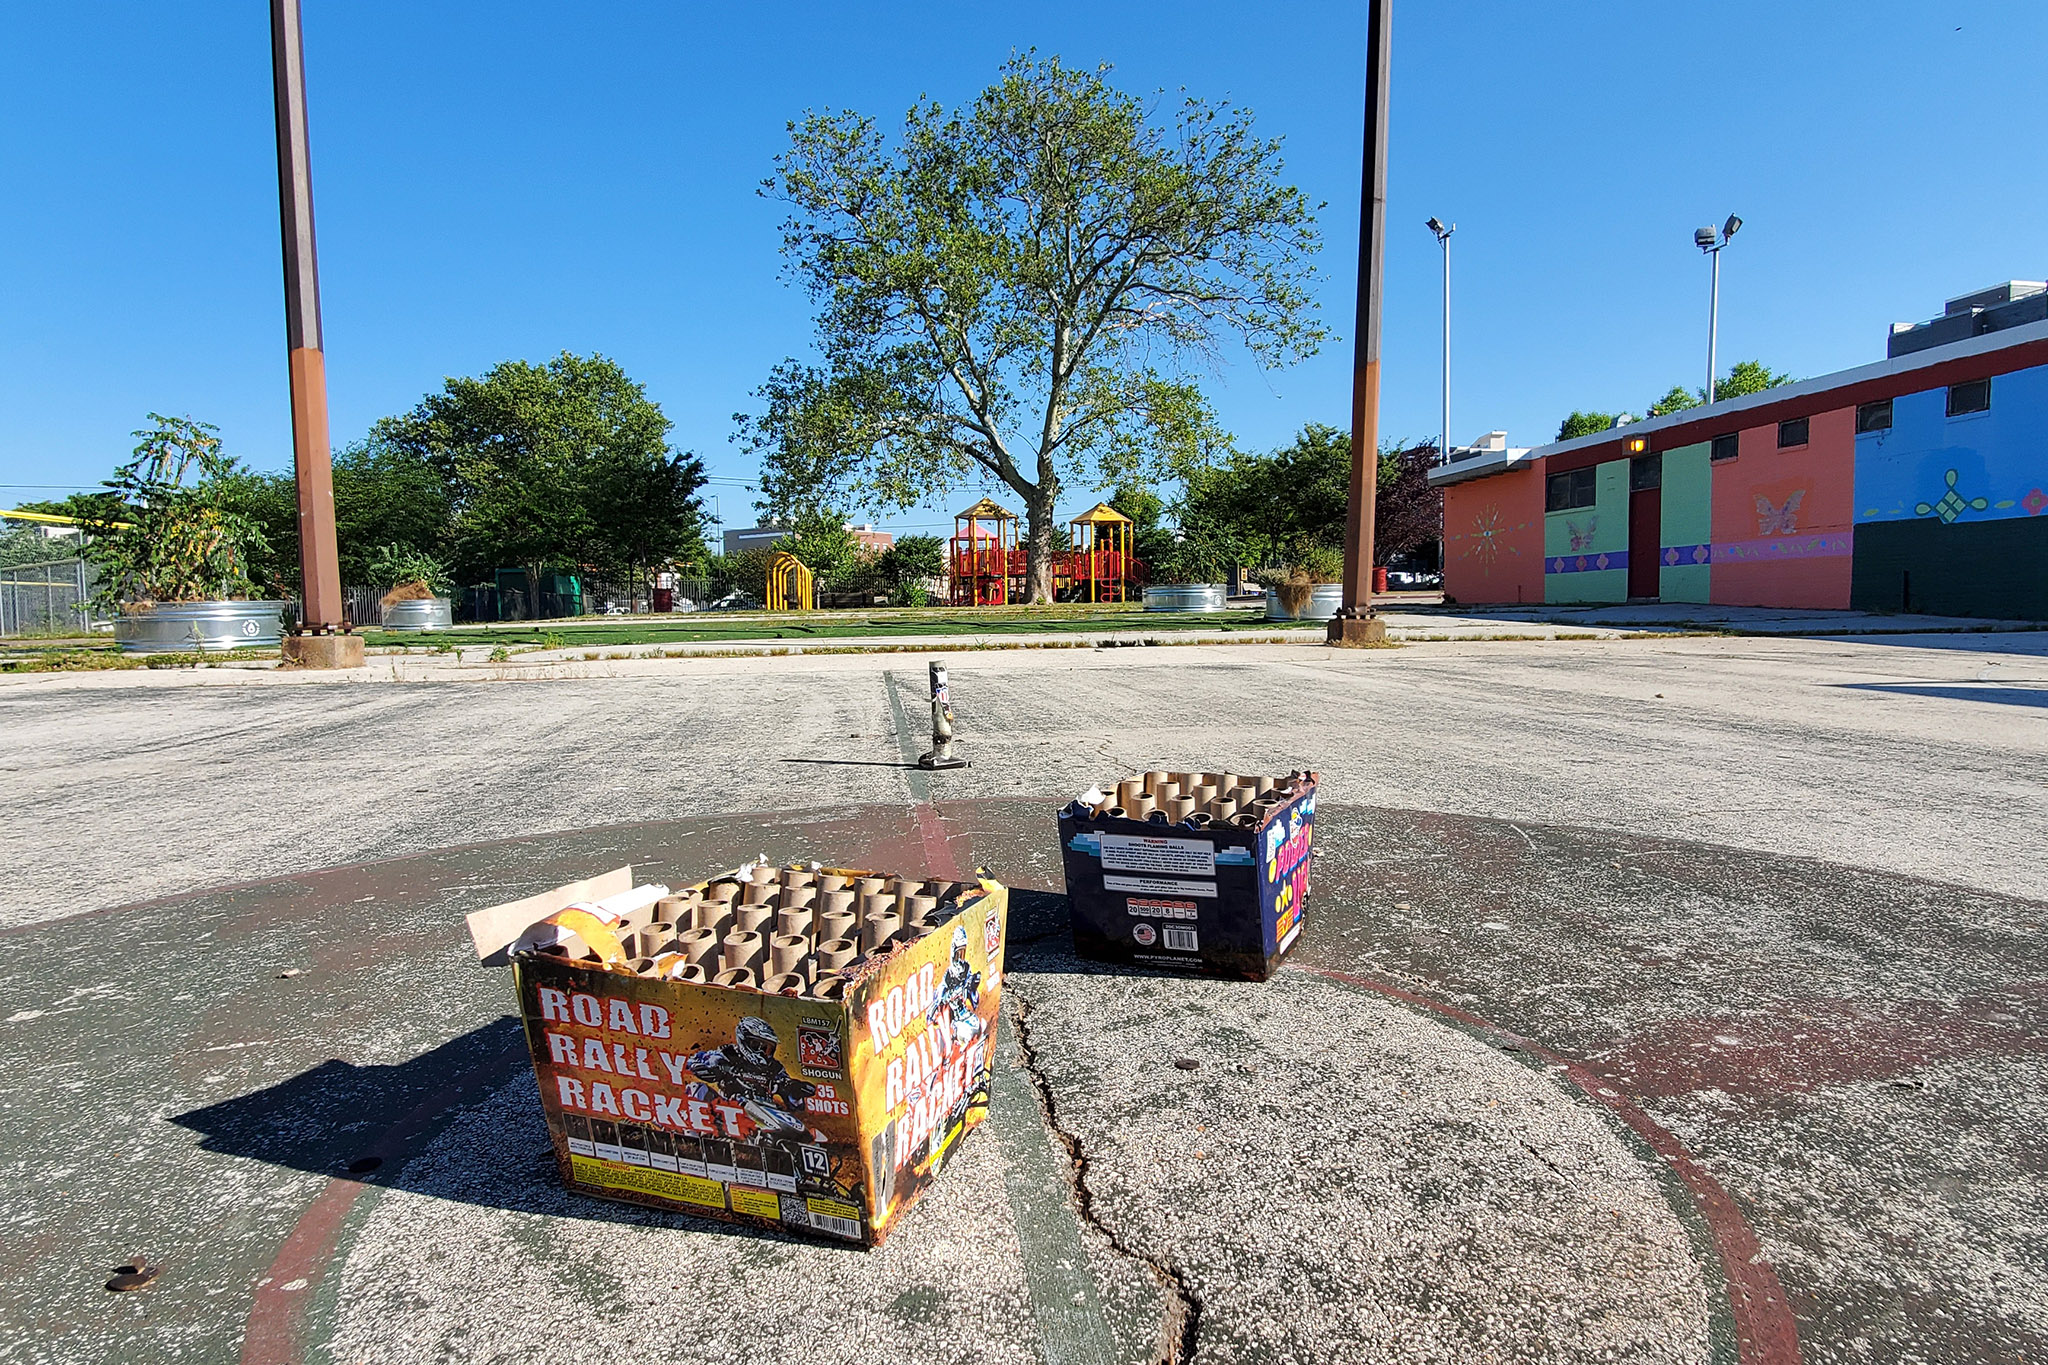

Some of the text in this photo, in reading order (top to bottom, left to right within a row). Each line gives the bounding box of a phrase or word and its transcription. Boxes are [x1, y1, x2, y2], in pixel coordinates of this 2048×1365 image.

[537, 987, 672, 1040] ROAD
[802, 1016, 831, 1027] LBM157
[868, 961, 935, 1054] ROAD
[548, 1032, 687, 1087] RALLY
[802, 1068, 842, 1080] SHOGUN
[885, 1008, 952, 1113] RALLY
[555, 1075, 745, 1137] RACKET
[806, 1098, 850, 1115] SHOTS
[816, 1084, 835, 1099] 35
[895, 1043, 976, 1168] RACKET
[599, 1161, 631, 1172] WARNING
[805, 1151, 826, 1171] 12
